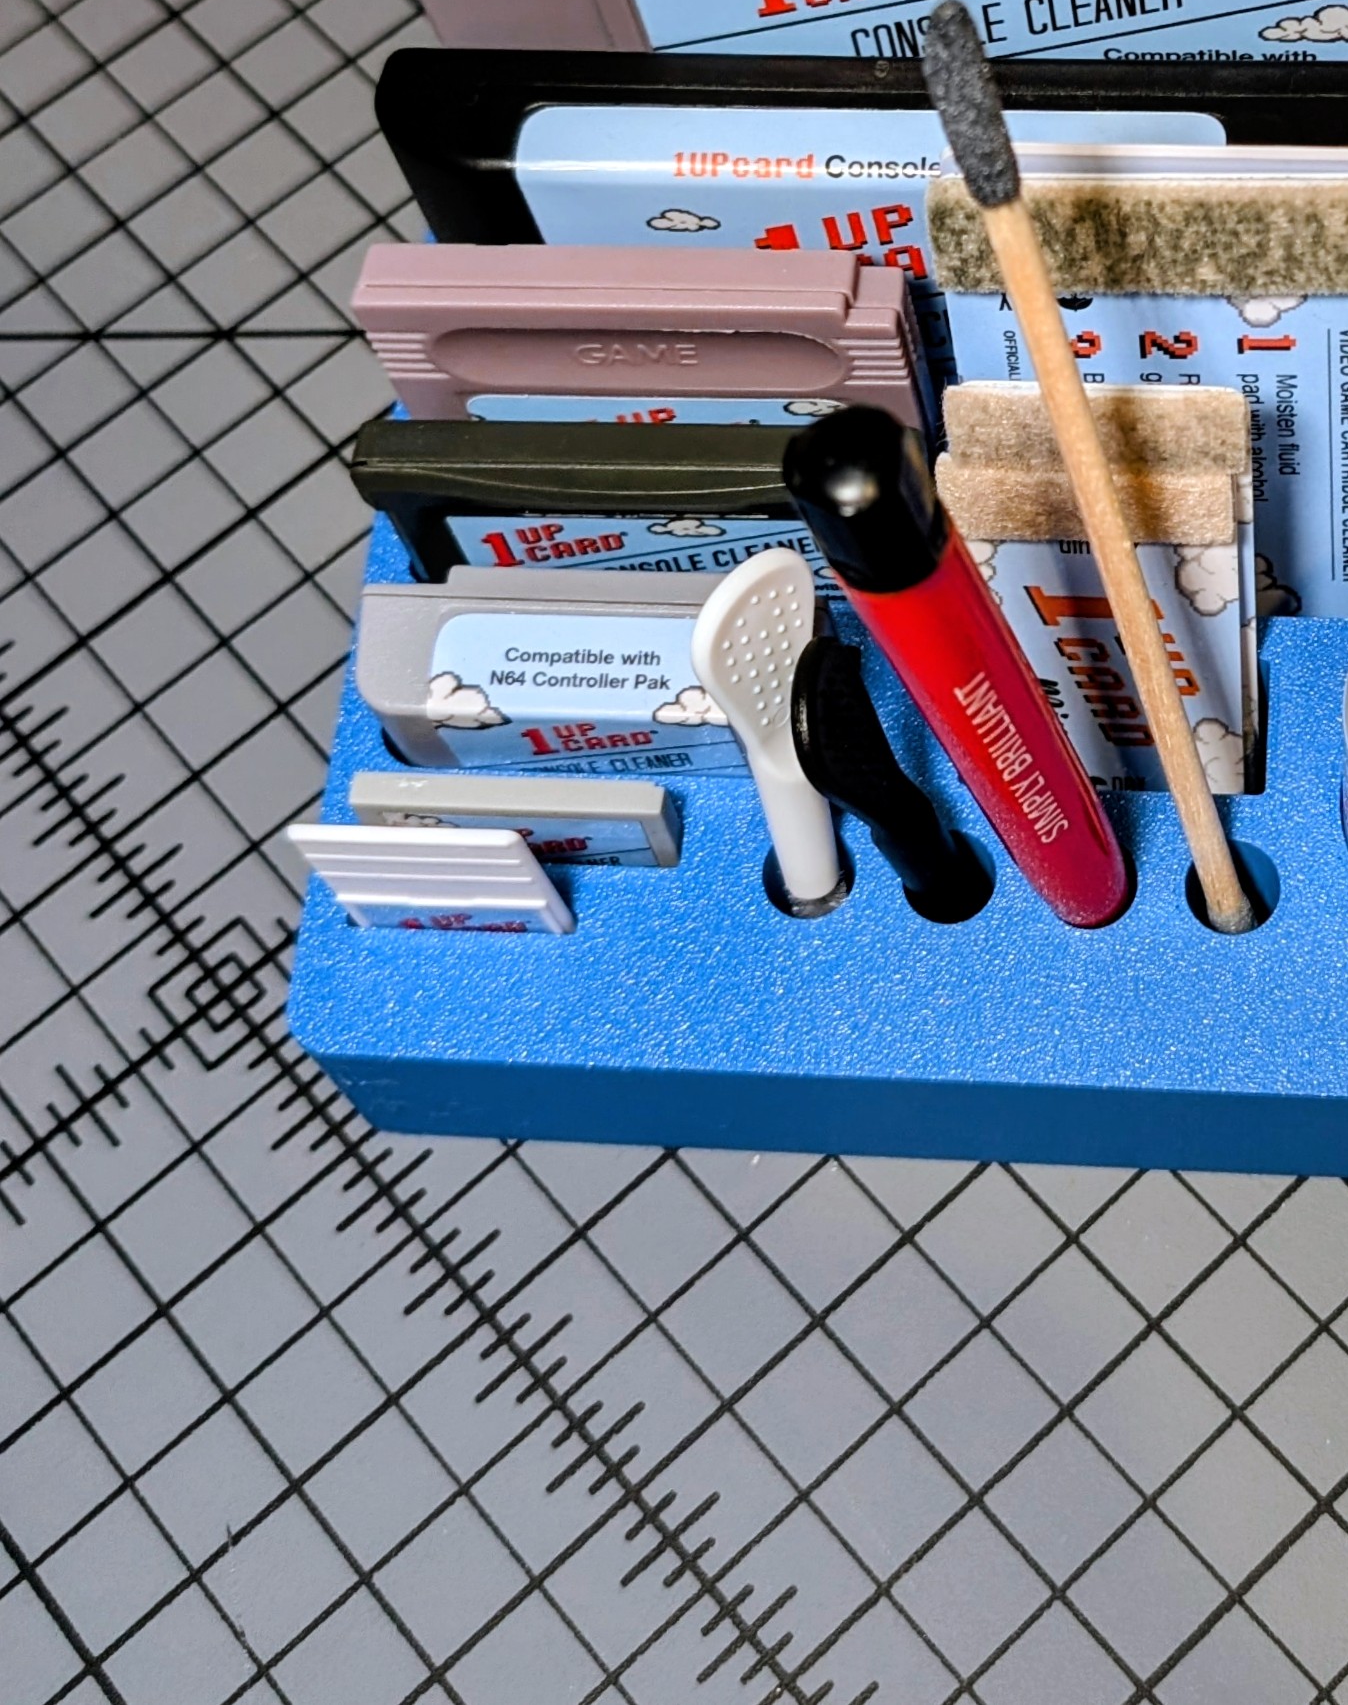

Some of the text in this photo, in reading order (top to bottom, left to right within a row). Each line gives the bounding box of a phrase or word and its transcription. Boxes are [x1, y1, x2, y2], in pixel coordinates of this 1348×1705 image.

[1261, 49, 1318, 63] with
[673, 151, 941, 180] 1UPcard Console
[822, 203, 914, 251] UP
[575, 343, 700, 367] GAME
[1138, 330, 1199, 360] 2
[1236, 372, 1265, 406] pad
[1274, 373, 1299, 439] Moisten
[1250, 407, 1267, 443] with
[1277, 442, 1301, 477] fluid
[514, 523, 564, 546] UP
[525, 532, 626, 563] CARD
[504, 646, 661, 667] Compatible with
[489, 669, 672, 691] N64 Controller Pak
[953, 671, 1034, 783] BRILLIANT
[609, 752, 694, 774] CLEANER
[1009, 770, 1070, 844] SIMPLY
